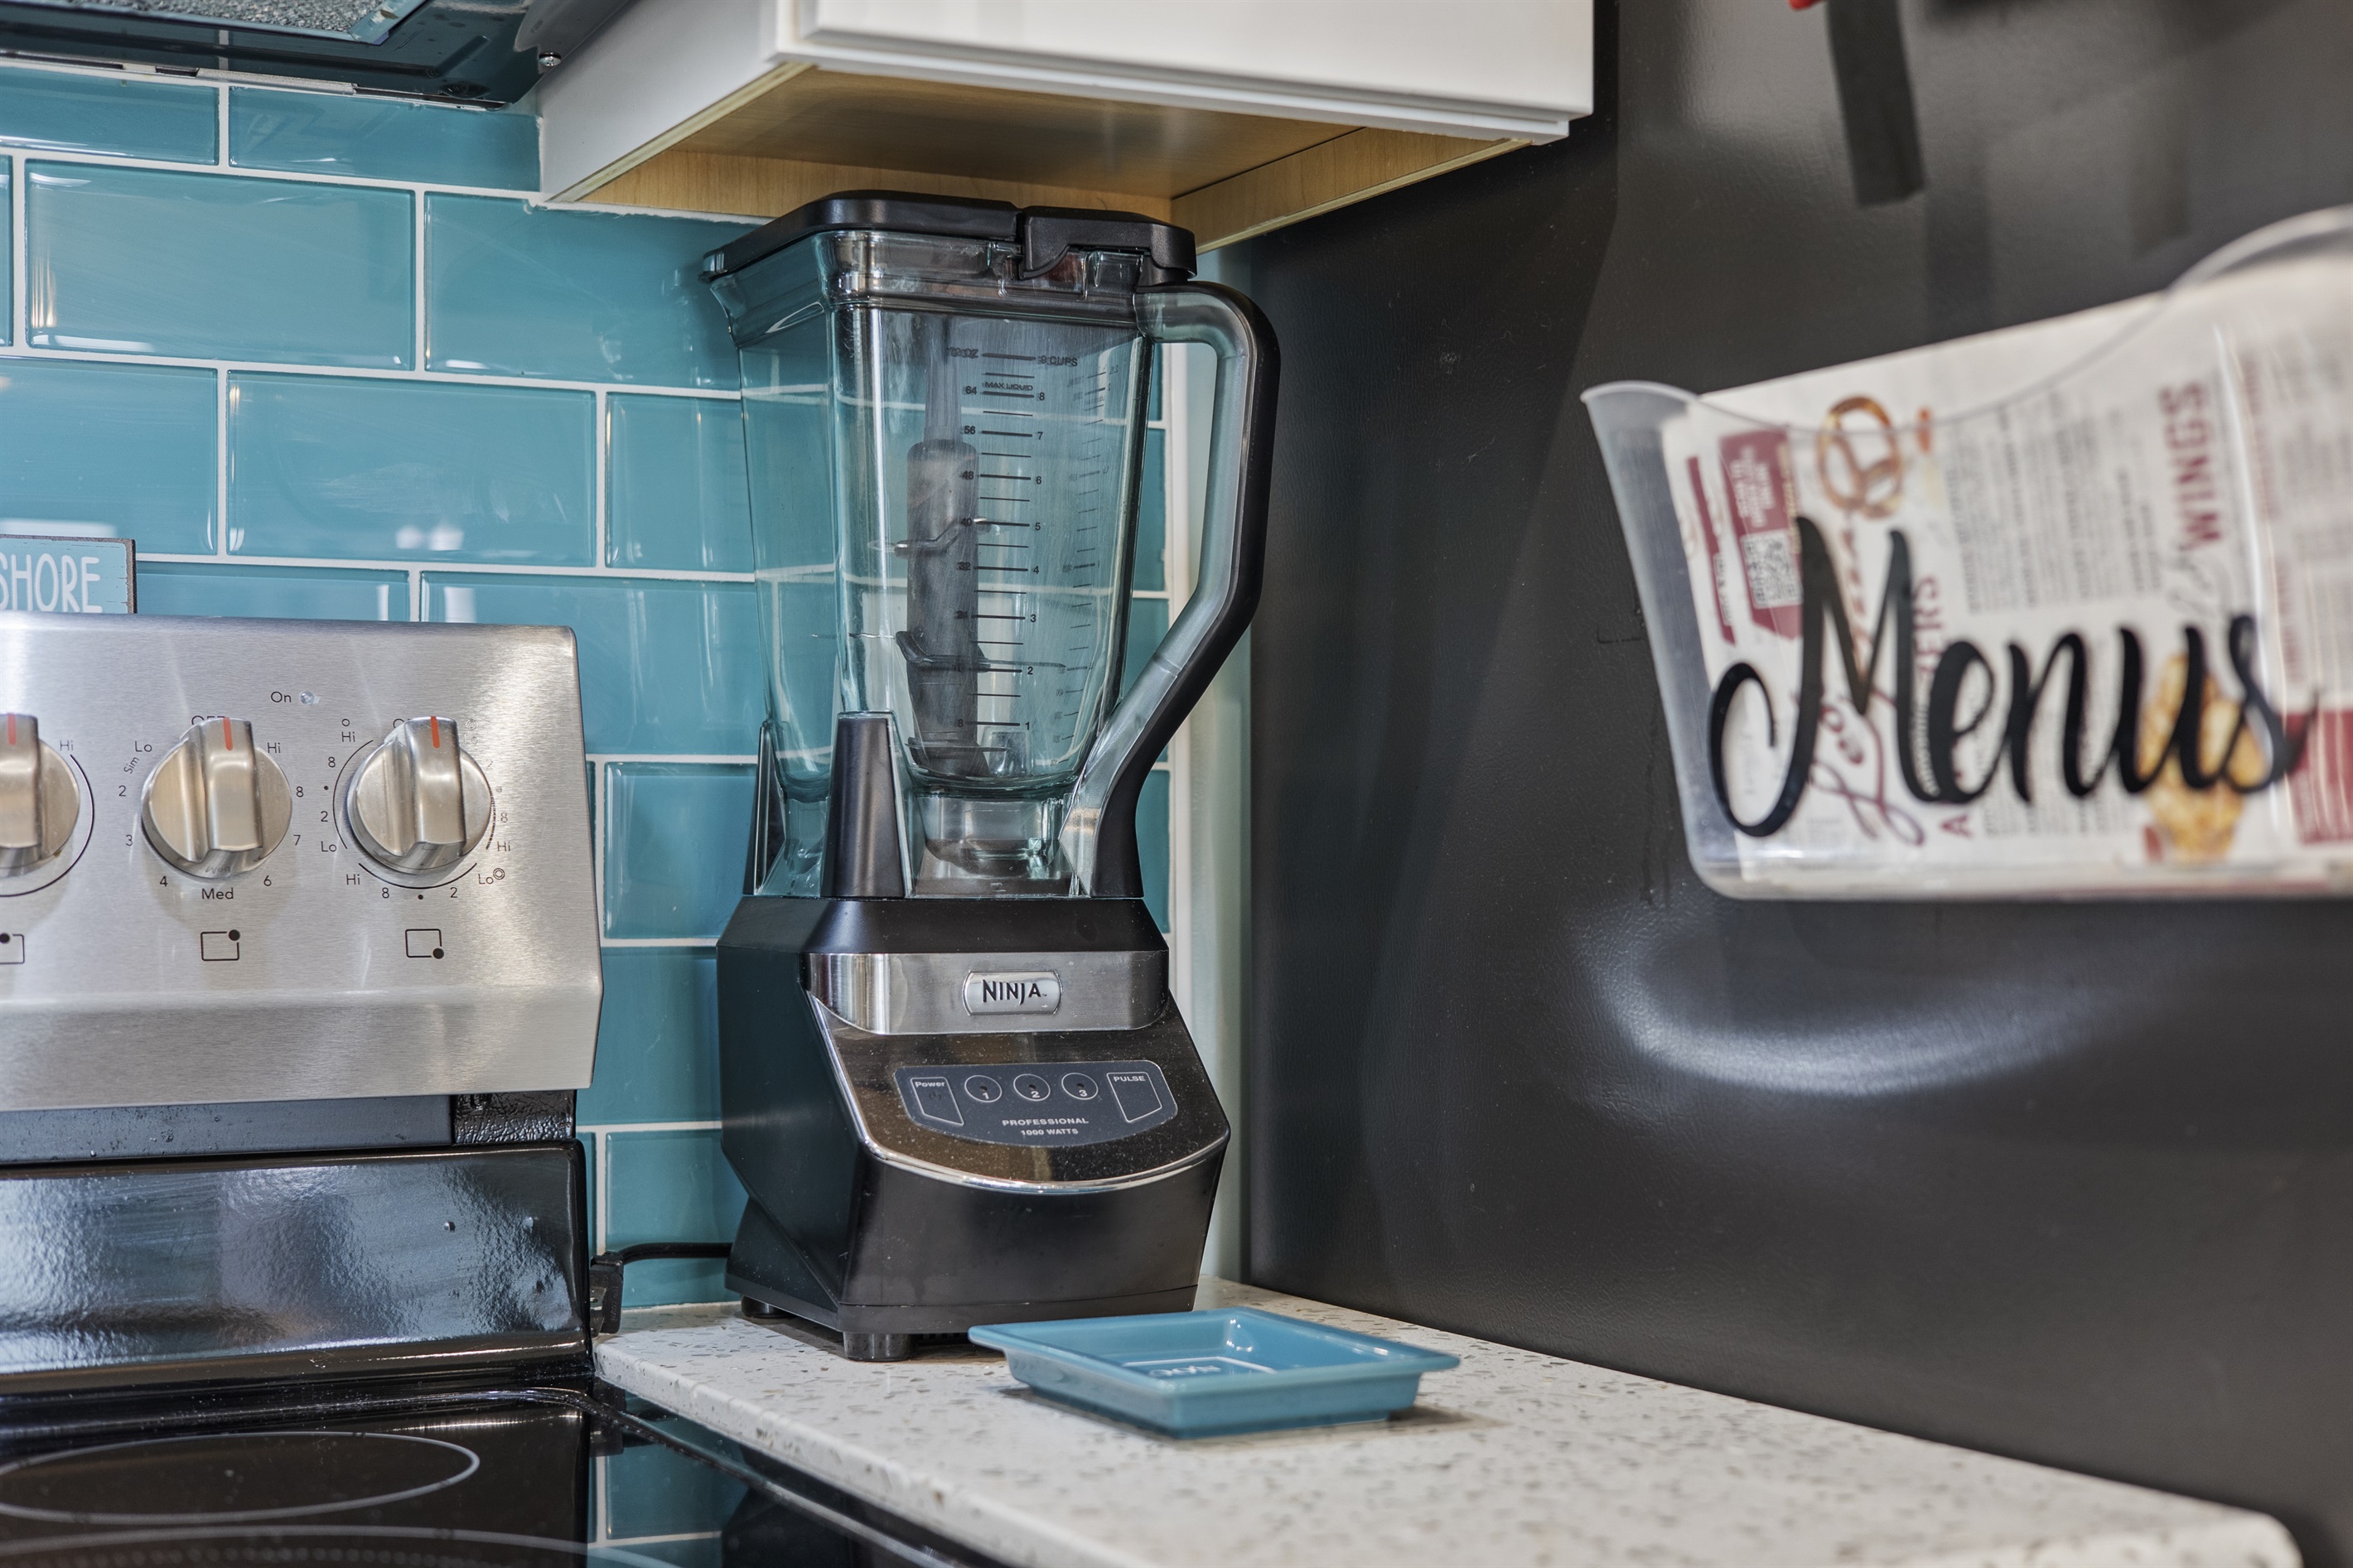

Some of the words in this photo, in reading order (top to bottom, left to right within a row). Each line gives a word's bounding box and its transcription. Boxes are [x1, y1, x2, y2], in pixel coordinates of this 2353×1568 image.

[1048, 356, 1078, 366] CUPS
[965, 386, 977, 395] 64
[983, 381, 1004, 389] MAX
[1039, 392, 1045, 401] 8
[964, 426, 976, 435] 56
[1037, 432, 1043, 440] 7
[2158, 381, 2222, 550] WINGS
[962, 470, 974, 480] 48
[1036, 475, 1042, 485] 6
[960, 518, 973, 527] 40
[1035, 522, 1041, 531] 5
[1033, 566, 1039, 574] 4
[1030, 614, 1036, 623] 3
[1027, 666, 1033, 675] 2
[1707, 514, 2320, 837] Menus
[270, 692, 292, 703] On
[957, 719, 964, 727] 8
[1025, 721, 1030, 731] 1
[341, 731, 355, 743] Hi
[60, 741, 74, 751] Hi
[134, 741, 152, 753] Lo
[267, 742, 281, 754] Hi
[123, 755, 140, 775] Sim
[327, 756, 336, 768] 8
[118, 785, 127, 797] 2
[296, 786, 304, 798] 8
[320, 810, 328, 823] 2
[500, 812, 509, 823] 8
[125, 835, 133, 847] 3
[292, 835, 301, 846] 7
[321, 841, 337, 852] Lo
[496, 841, 511, 852] Hi
[159, 876, 168, 887] 4
[263, 876, 272, 886] 6
[345, 874, 360, 885] Hi
[477, 873, 494, 885] Lo
[201, 888, 234, 900] Med
[381, 887, 390, 899] 8
[450, 887, 458, 899] 2
[983, 979, 1041, 1006] NINJA
[982, 1092, 989, 1100] 1
[1031, 1090, 1041, 1098] 2
[1078, 1089, 1088, 1098] 3
[1002, 1117, 1090, 1127] PROFESSIONAL
[1046, 1127, 1079, 1136] WATTS
